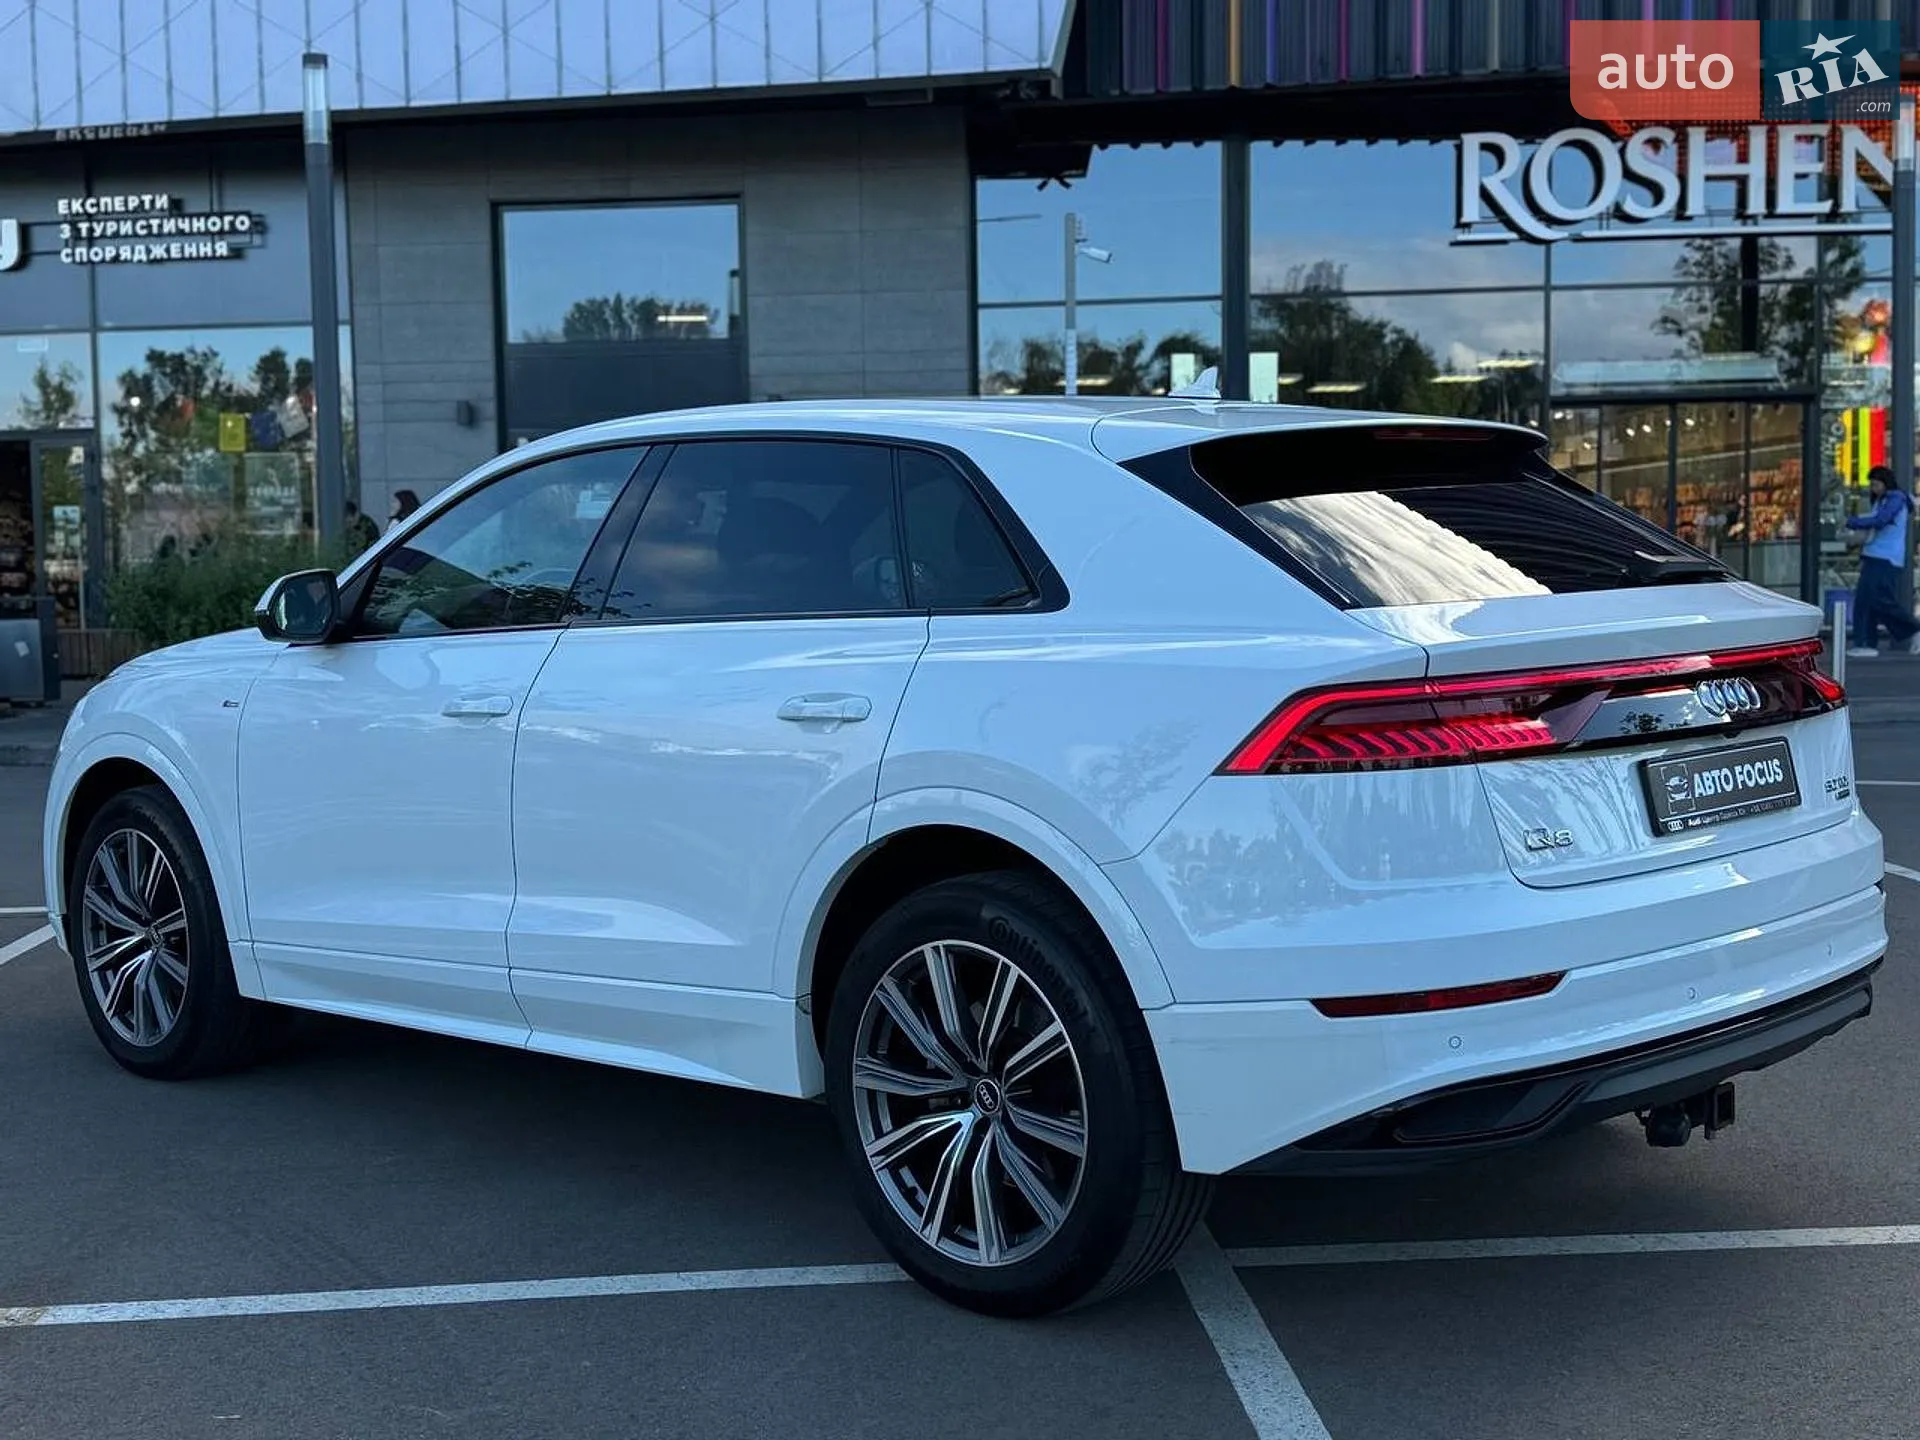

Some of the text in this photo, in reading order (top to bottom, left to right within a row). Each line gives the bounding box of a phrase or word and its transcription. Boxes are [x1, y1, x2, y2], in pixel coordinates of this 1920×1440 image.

[1460, 124, 1893, 241] ROSHEN
[57, 194, 169, 215] ЕКСПЕРТИ
[77, 215, 251, 238] ТУРИСТИЧНОГО
[60, 241, 229, 264] СПОРЯДЖЕННЯ
[1734, 759, 1784, 789] FOCUS
